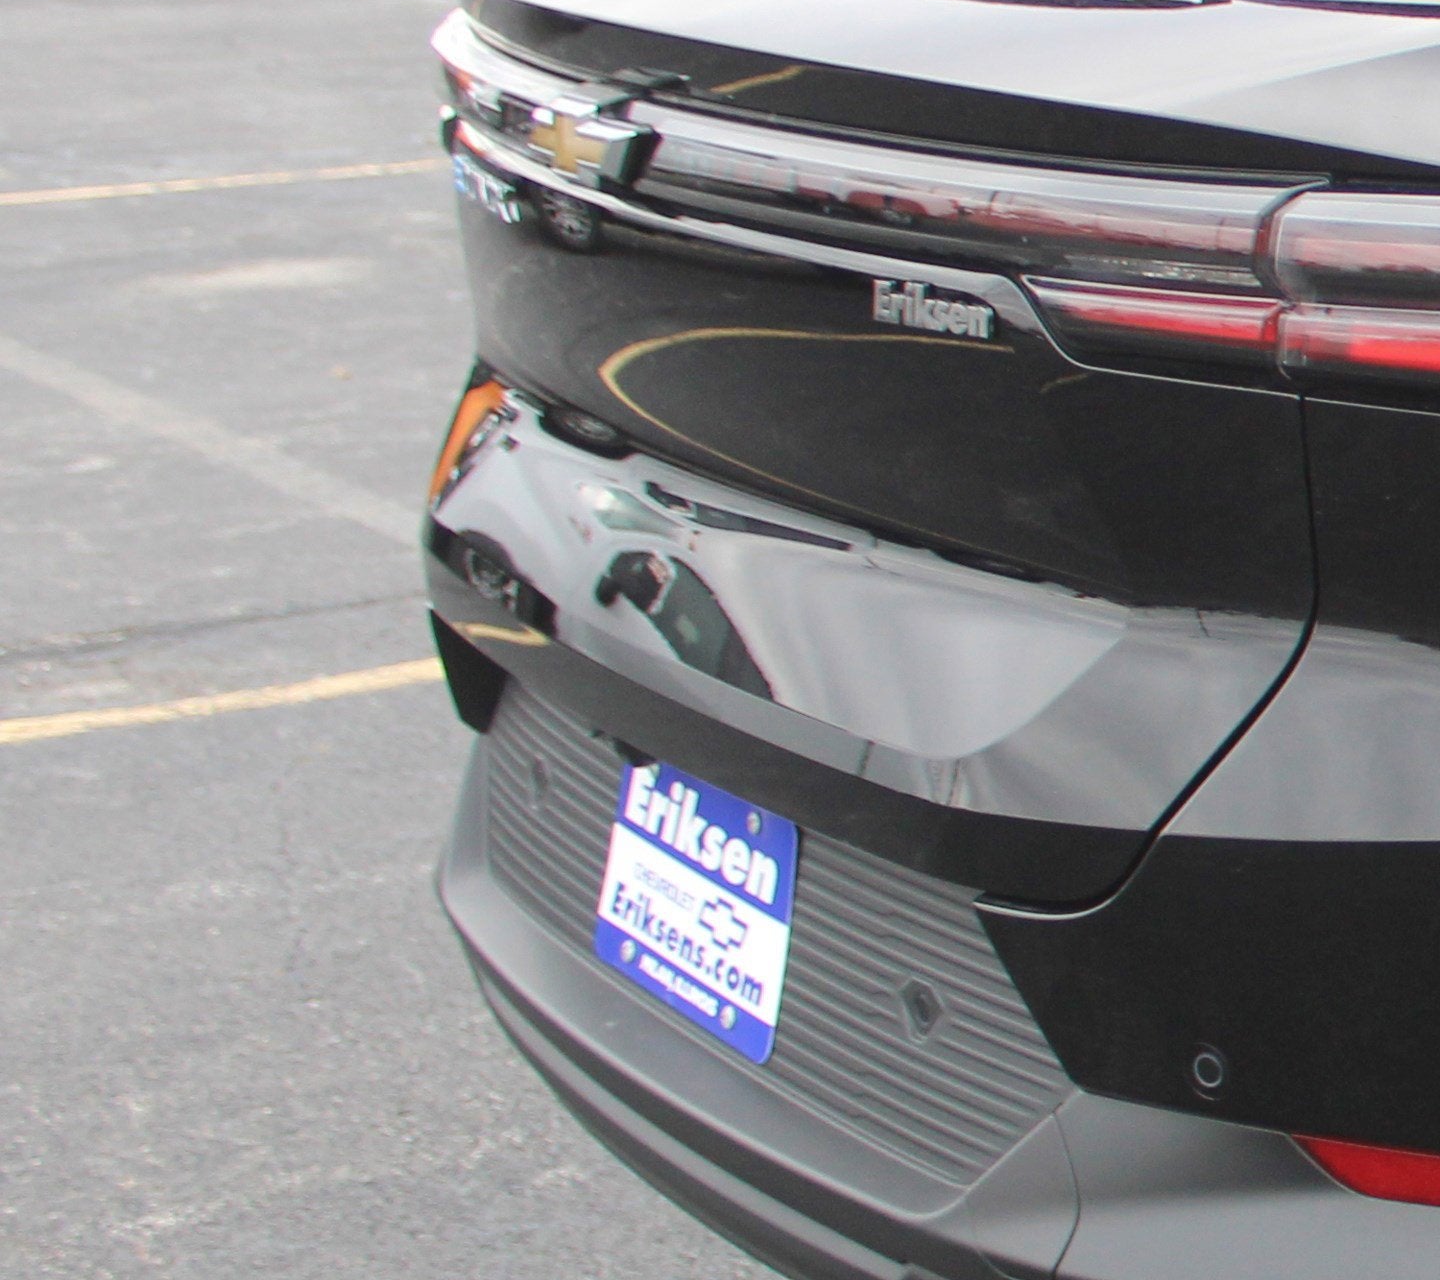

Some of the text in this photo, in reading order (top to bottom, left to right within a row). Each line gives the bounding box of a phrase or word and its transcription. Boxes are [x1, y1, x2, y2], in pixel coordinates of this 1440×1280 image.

[873, 279, 992, 340] Eriksen
[624, 765, 779, 906] Eriksen
[610, 879, 765, 1007] Eriksens.com
